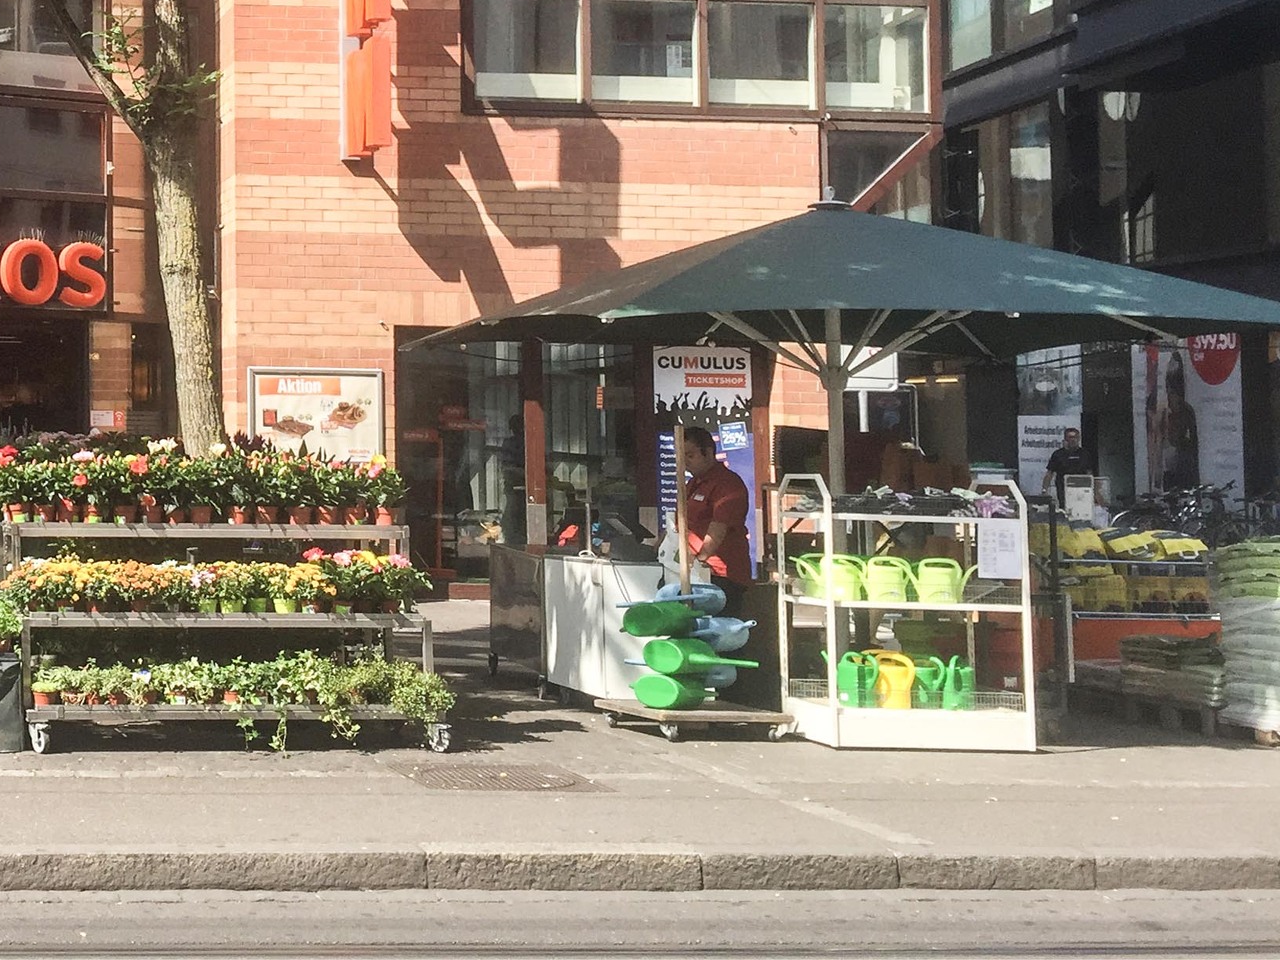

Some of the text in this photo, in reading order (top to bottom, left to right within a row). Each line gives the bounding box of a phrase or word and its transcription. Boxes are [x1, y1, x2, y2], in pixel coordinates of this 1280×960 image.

[658, 356, 746, 370] CUMULUS
[277, 378, 322, 394] Aktion
[687, 376, 744, 385] TICKETSHOP
[722, 431, 747, 444] 25%
